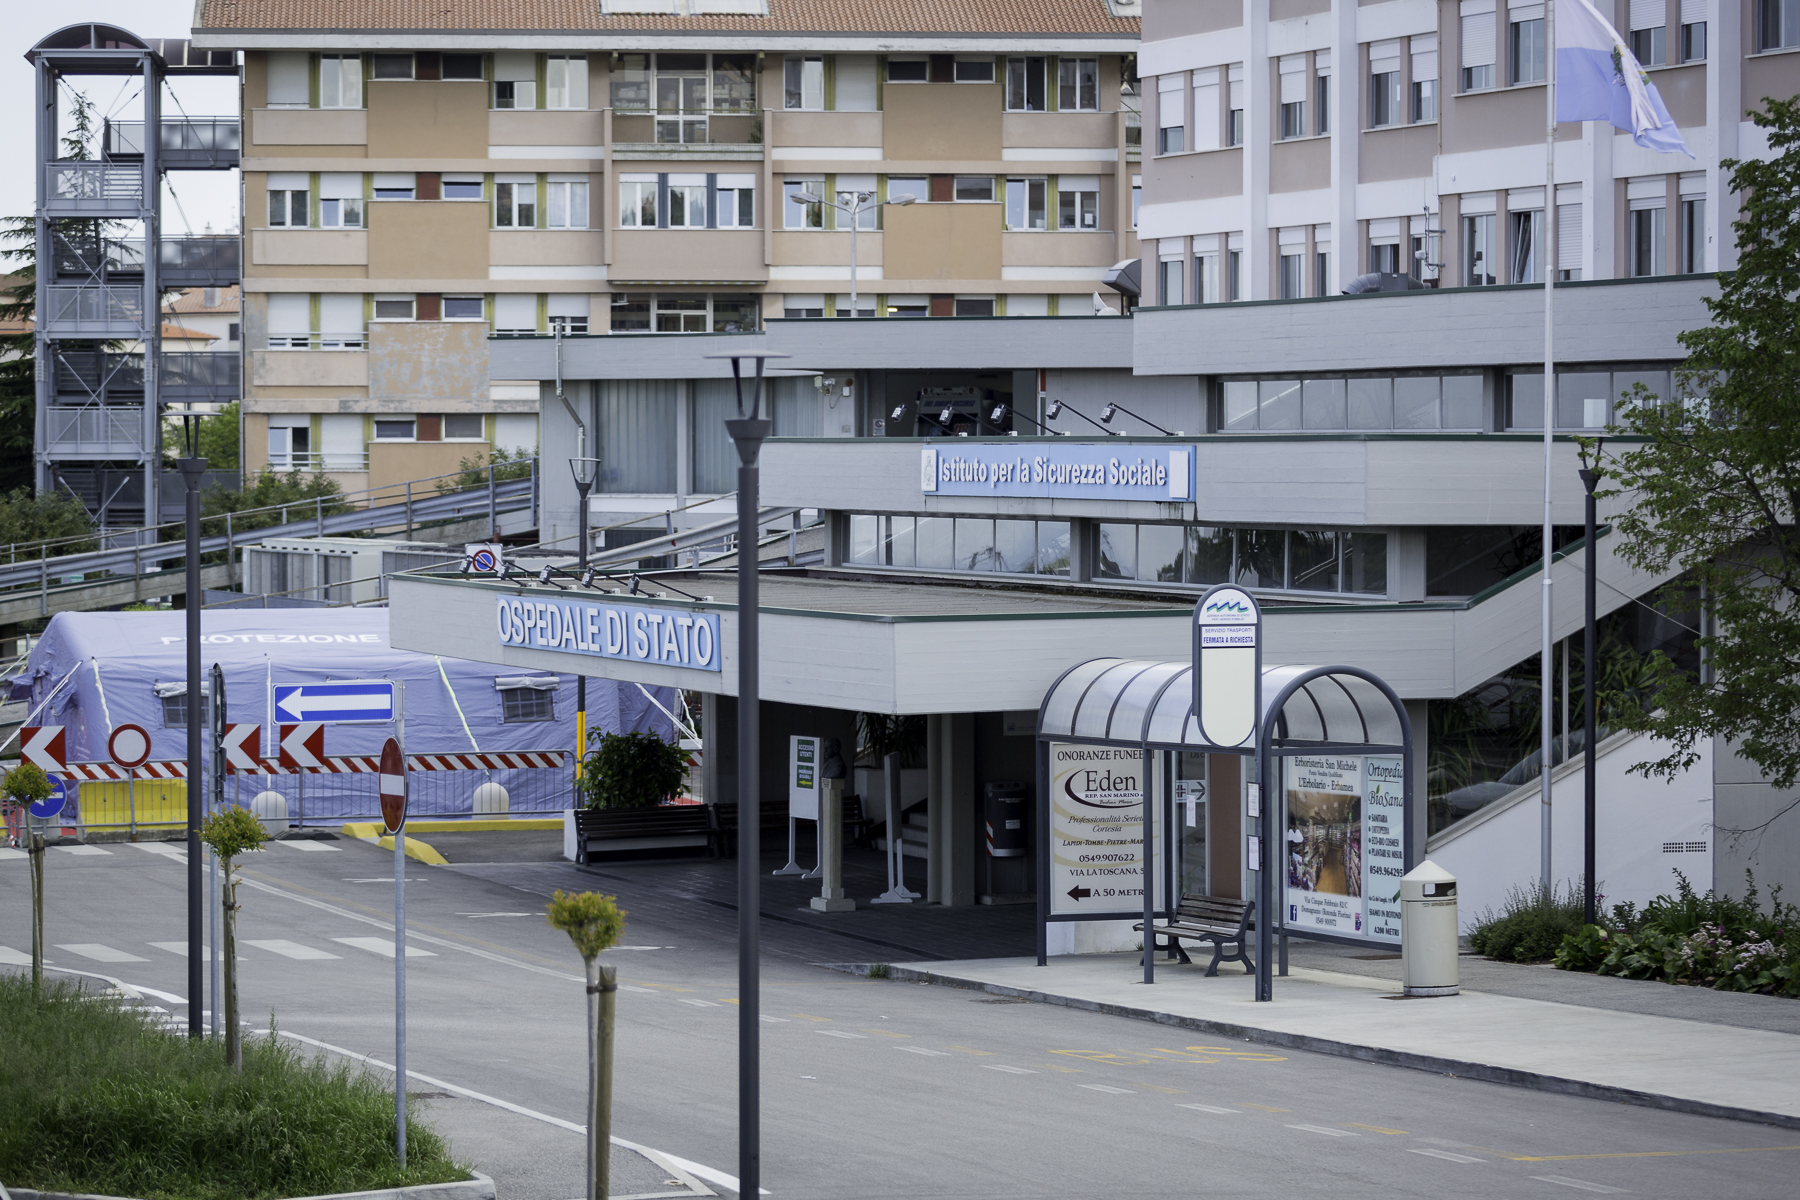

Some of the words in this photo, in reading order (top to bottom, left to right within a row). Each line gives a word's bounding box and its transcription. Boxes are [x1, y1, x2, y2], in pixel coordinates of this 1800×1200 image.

[939, 456, 987, 483] Istituto
[991, 461, 1014, 488] per
[1017, 456, 1030, 483] la
[1034, 456, 1105, 484] Sicurezza
[1109, 457, 1167, 486] Sociale
[498, 599, 600, 651] OSPEDALE
[606, 610, 628, 655] DI
[634, 611, 713, 666] STATO
[1057, 750, 1111, 761] ONORANZE
[1113, 750, 1155, 760] FUNEBI
[1295, 757, 1324, 768] Erboristeria
[1325, 759, 1335, 770] San
[1336, 760, 1357, 771] Michele
[1085, 770, 1137, 791] Eden
[1068, 815, 1121, 825] Professionalità
[1079, 854, 1135, 862] 0549.907622
[1392, 850, 1402, 859] MISUR
[1369, 865, 1403, 877] 0549.964295
[1386, 911, 1401, 919] ROTOND
